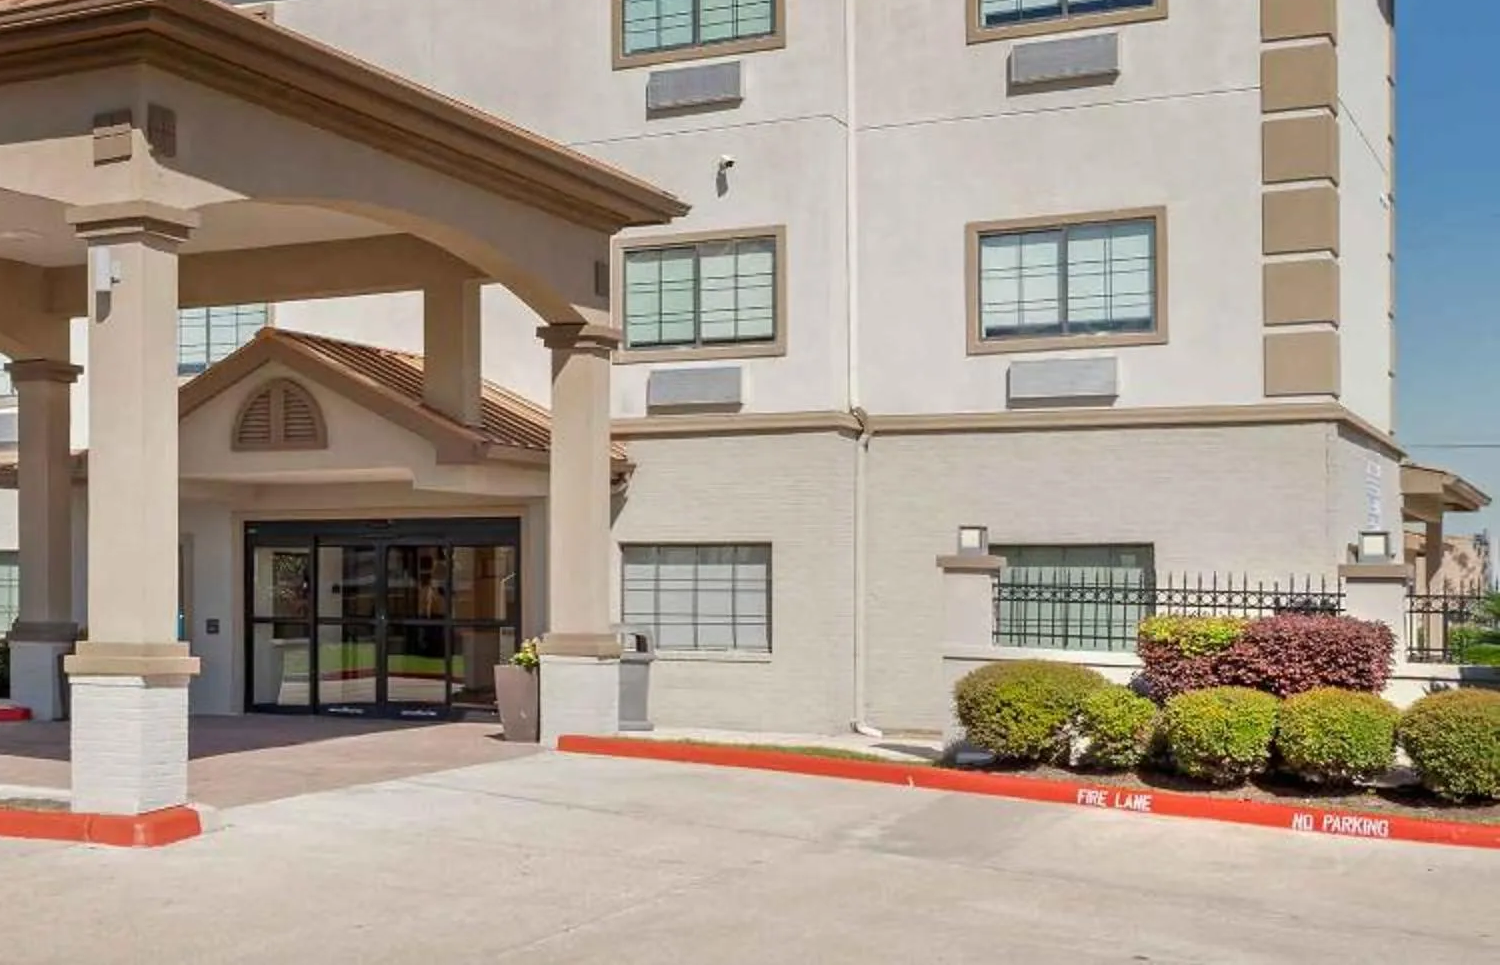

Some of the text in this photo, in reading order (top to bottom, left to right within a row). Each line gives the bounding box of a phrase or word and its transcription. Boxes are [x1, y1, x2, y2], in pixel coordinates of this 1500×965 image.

[1077, 788, 1153, 812] FIRE LANE
[1292, 812, 1389, 837] NO PARKING
